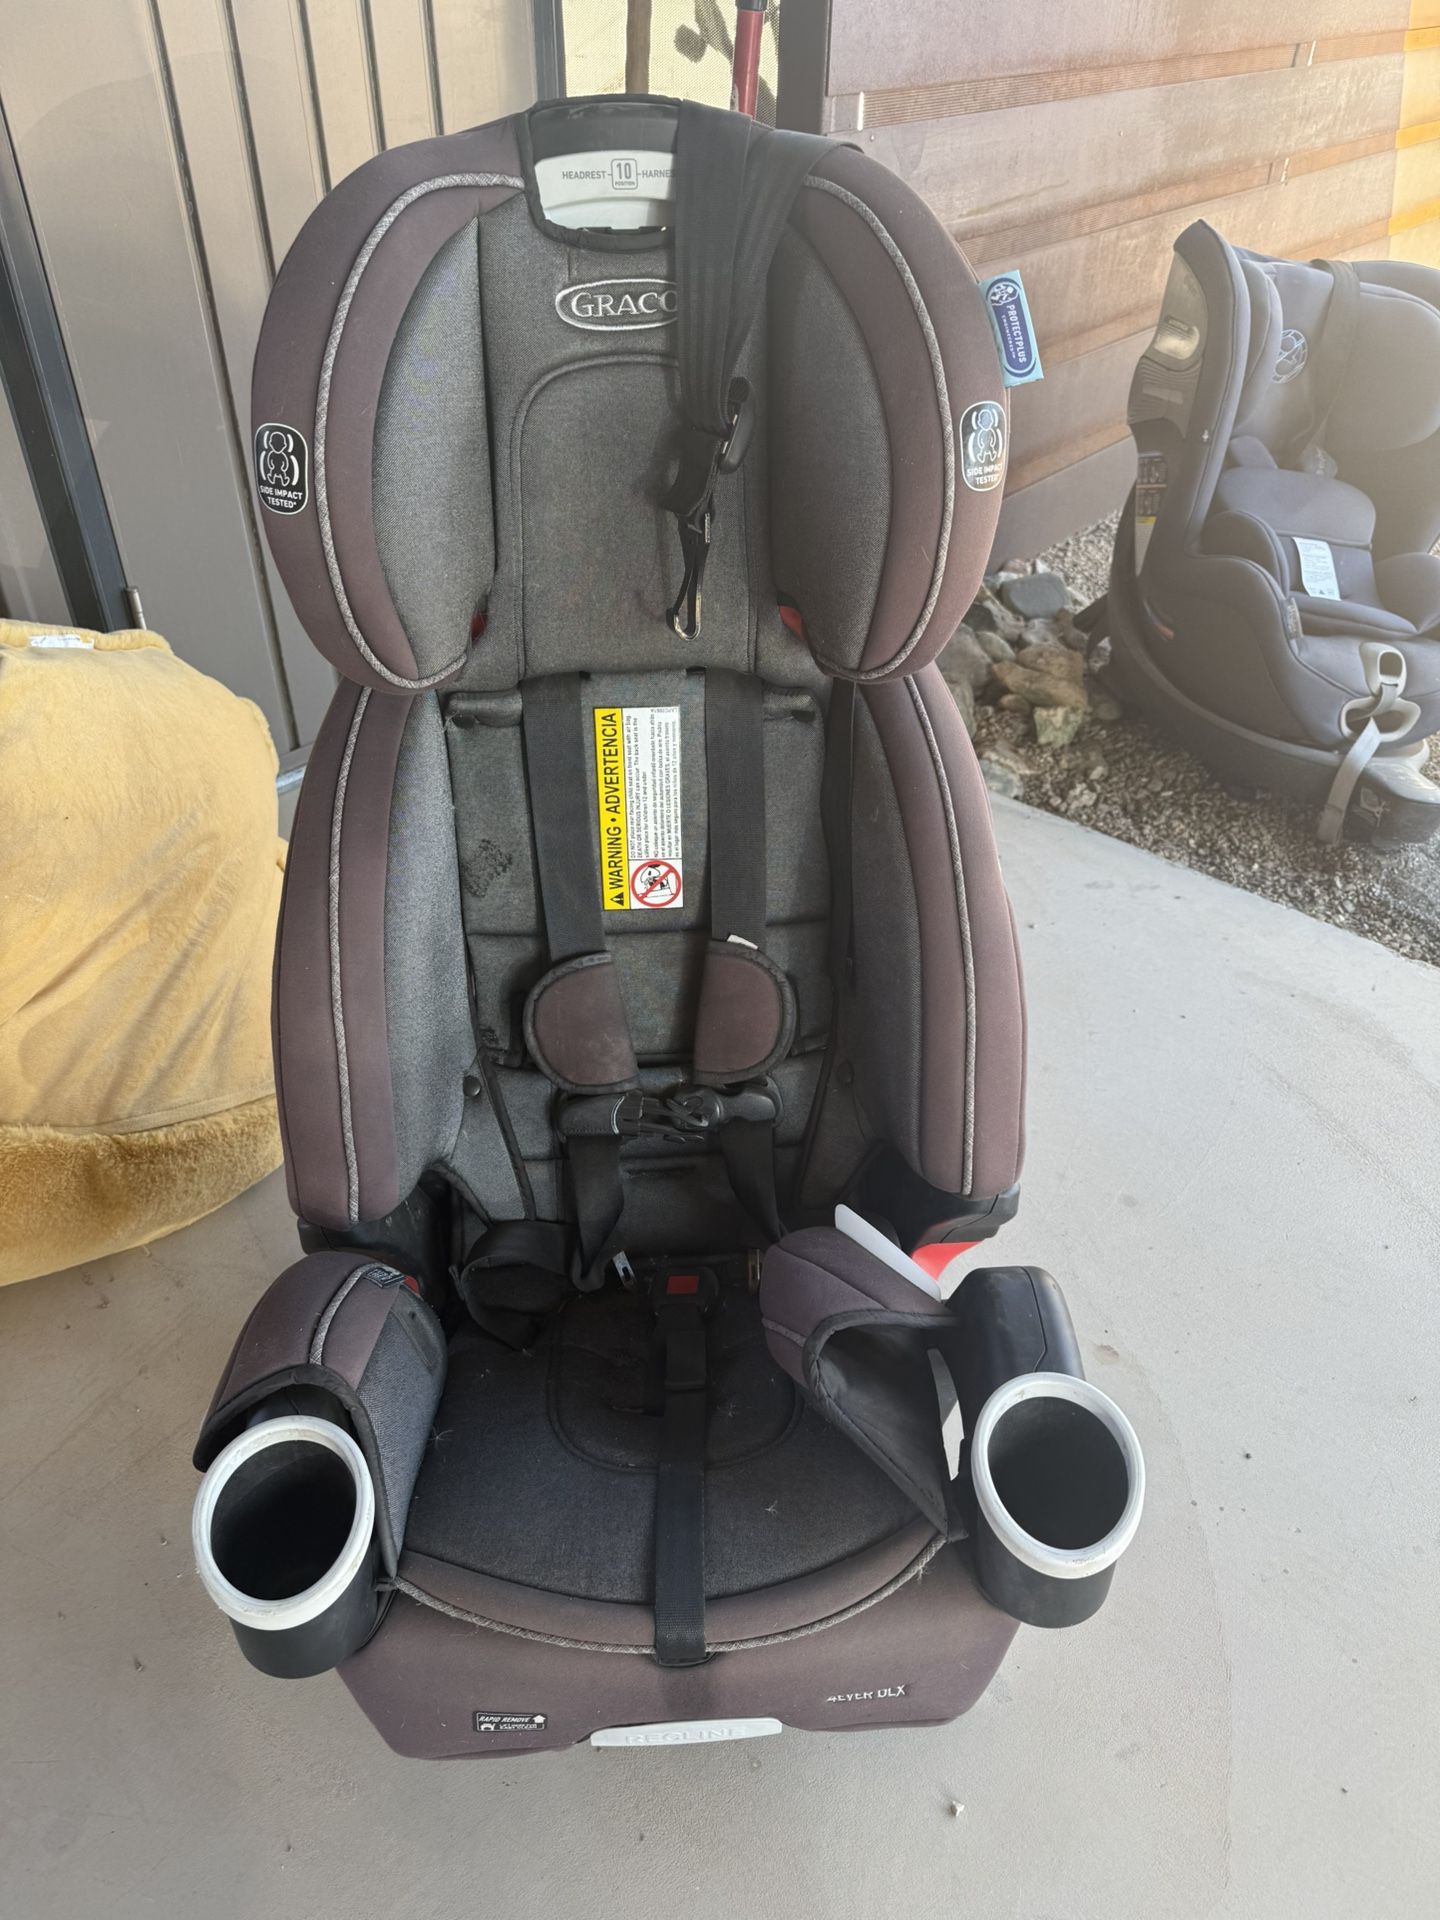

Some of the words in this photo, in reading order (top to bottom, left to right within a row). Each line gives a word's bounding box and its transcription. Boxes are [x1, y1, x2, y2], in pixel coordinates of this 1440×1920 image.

[562, 170, 607, 180] HEADREST
[616, 162, 632, 180] 10
[642, 169, 676, 178] HARNES
[571, 290, 677, 318] GRACO
[1005, 304, 1027, 363] PROTECTPLUS
[966, 466, 983, 477] SIDE
[983, 463, 1002, 474] IMPACT
[260, 485, 273, 495] SIDE
[275, 488, 303, 500] IMPACT
[600, 712, 620, 814] ADVERTENCIA
[606, 826, 623, 889] WARNING
